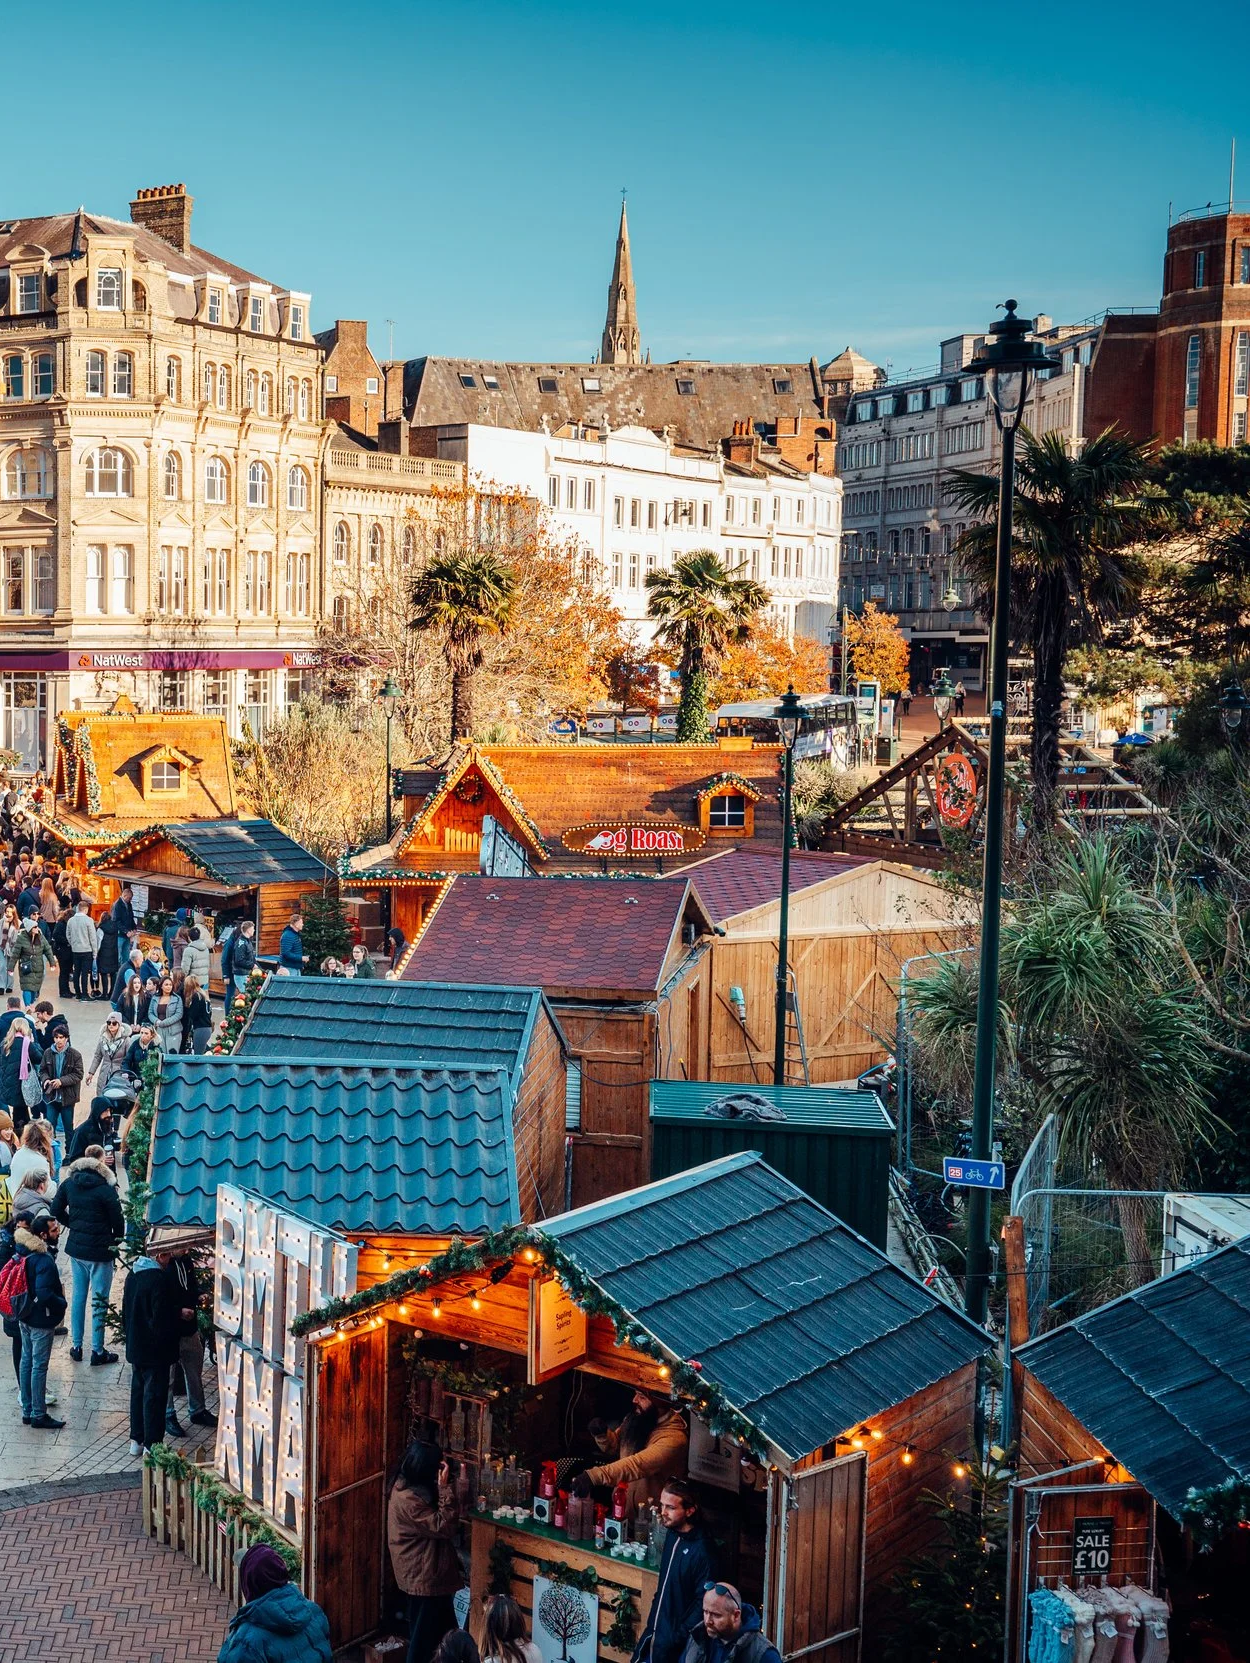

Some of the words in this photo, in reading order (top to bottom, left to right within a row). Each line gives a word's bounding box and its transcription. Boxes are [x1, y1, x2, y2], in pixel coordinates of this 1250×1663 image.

[92, 654, 143, 667] NatWest
[584, 829, 627, 852] og
[950, 1169, 961, 1177] 25
[555, 1310, 572, 1321] Sapling
[556, 1319, 571, 1330] Spirits
[214, 1331, 304, 1543] XMA
[1076, 1535, 1110, 1548] SALE
[1074, 1550, 1109, 1568] £10
